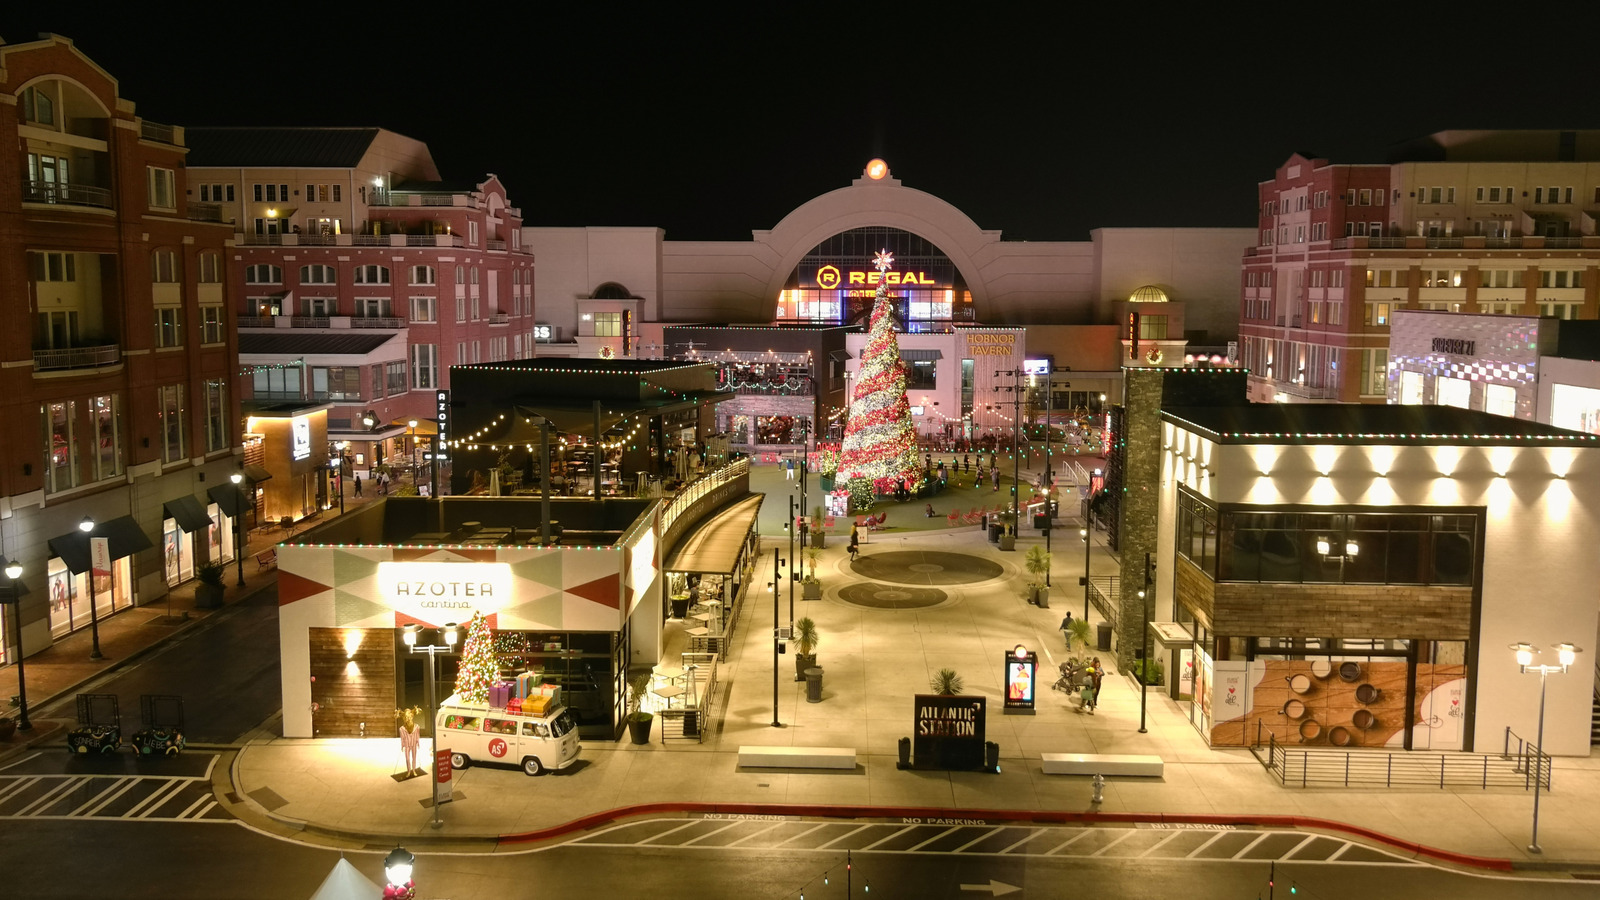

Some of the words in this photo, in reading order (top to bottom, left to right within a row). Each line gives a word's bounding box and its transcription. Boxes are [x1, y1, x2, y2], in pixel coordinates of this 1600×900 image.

[849, 271, 935, 285] REGAL
[966, 334, 1016, 344] HOBNOB
[970, 345, 1012, 356] TAVERN
[438, 392, 447, 451] AZOTEA
[397, 581, 493, 597] AZOTEA
[420, 599, 472, 609] cantina
[920, 706, 976, 721] ATLANTIC
[920, 720, 975, 736] STATION
[491, 744, 502, 754] AS
[728, 813, 786, 821] PARKING
[927, 817, 987, 825] PARKING
